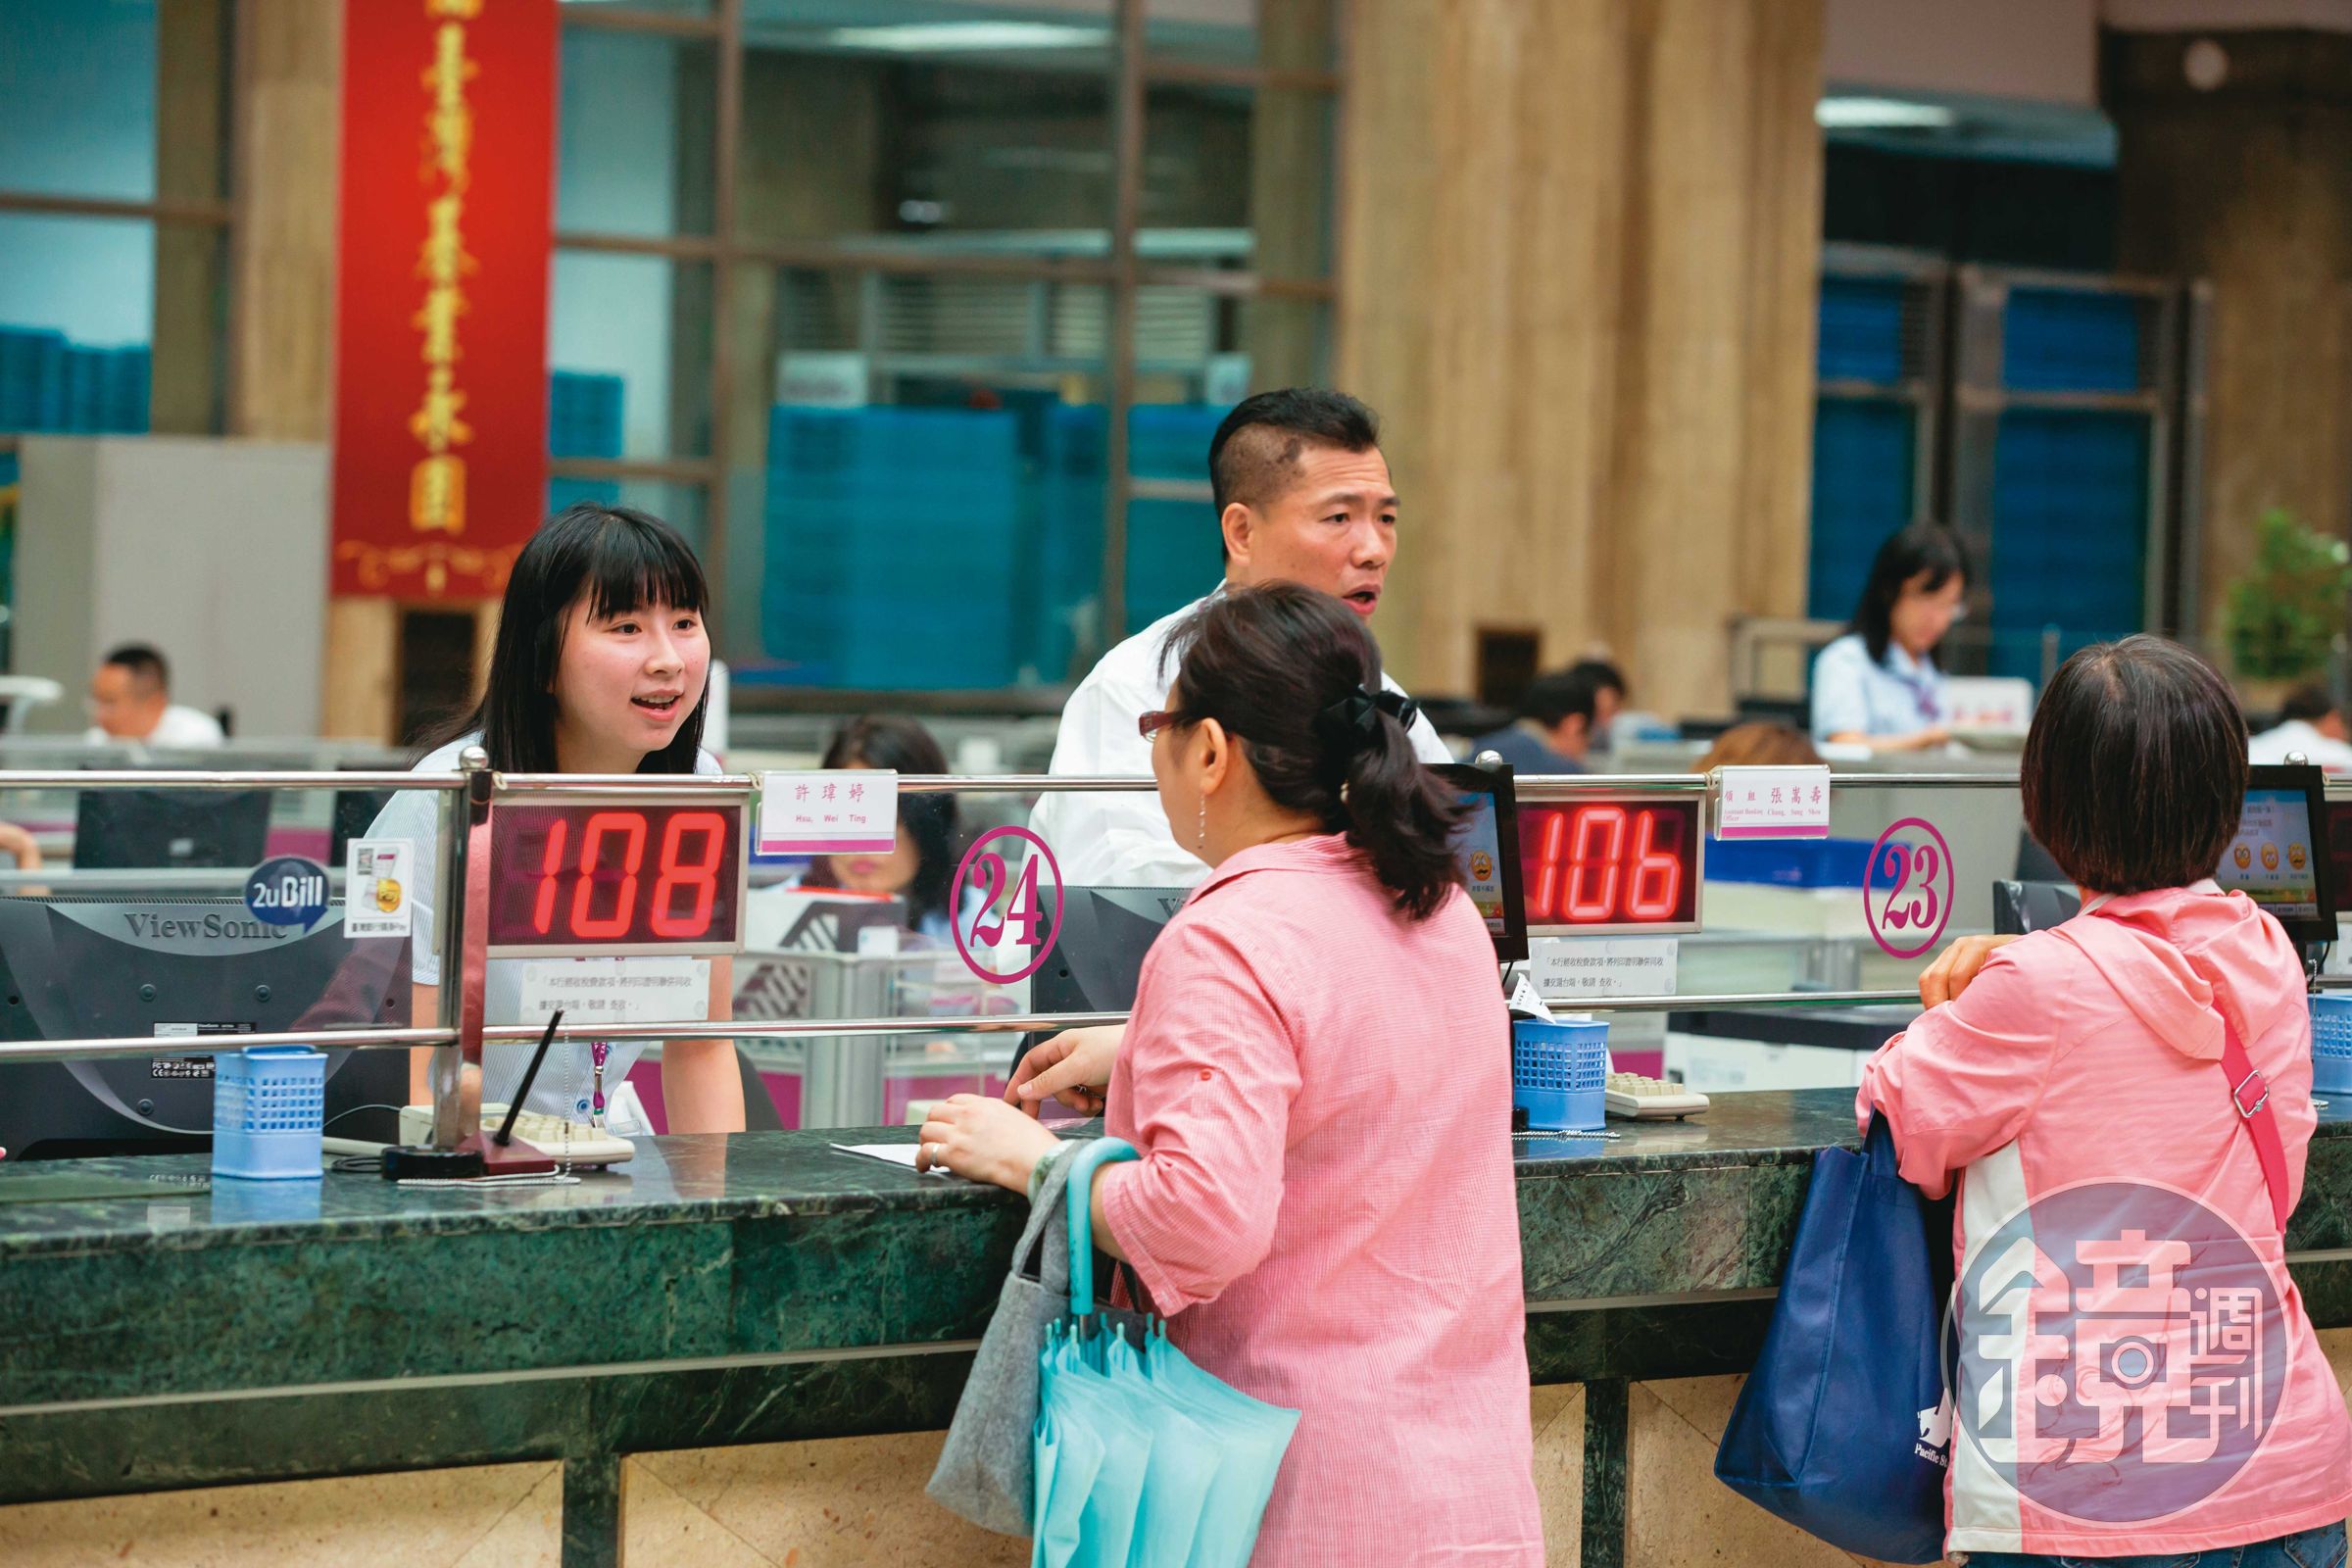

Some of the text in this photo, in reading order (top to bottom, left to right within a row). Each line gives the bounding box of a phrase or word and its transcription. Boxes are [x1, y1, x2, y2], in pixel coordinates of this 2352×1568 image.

[849, 814, 866, 823] Ting
[252, 876, 323, 908] 2uBill
[534, 812, 726, 938] 108
[970, 853, 1043, 948] 24
[1535, 807, 1681, 920] 106
[1882, 845, 1939, 930] 23
[1914, 1443, 1939, 1463] Pacific
